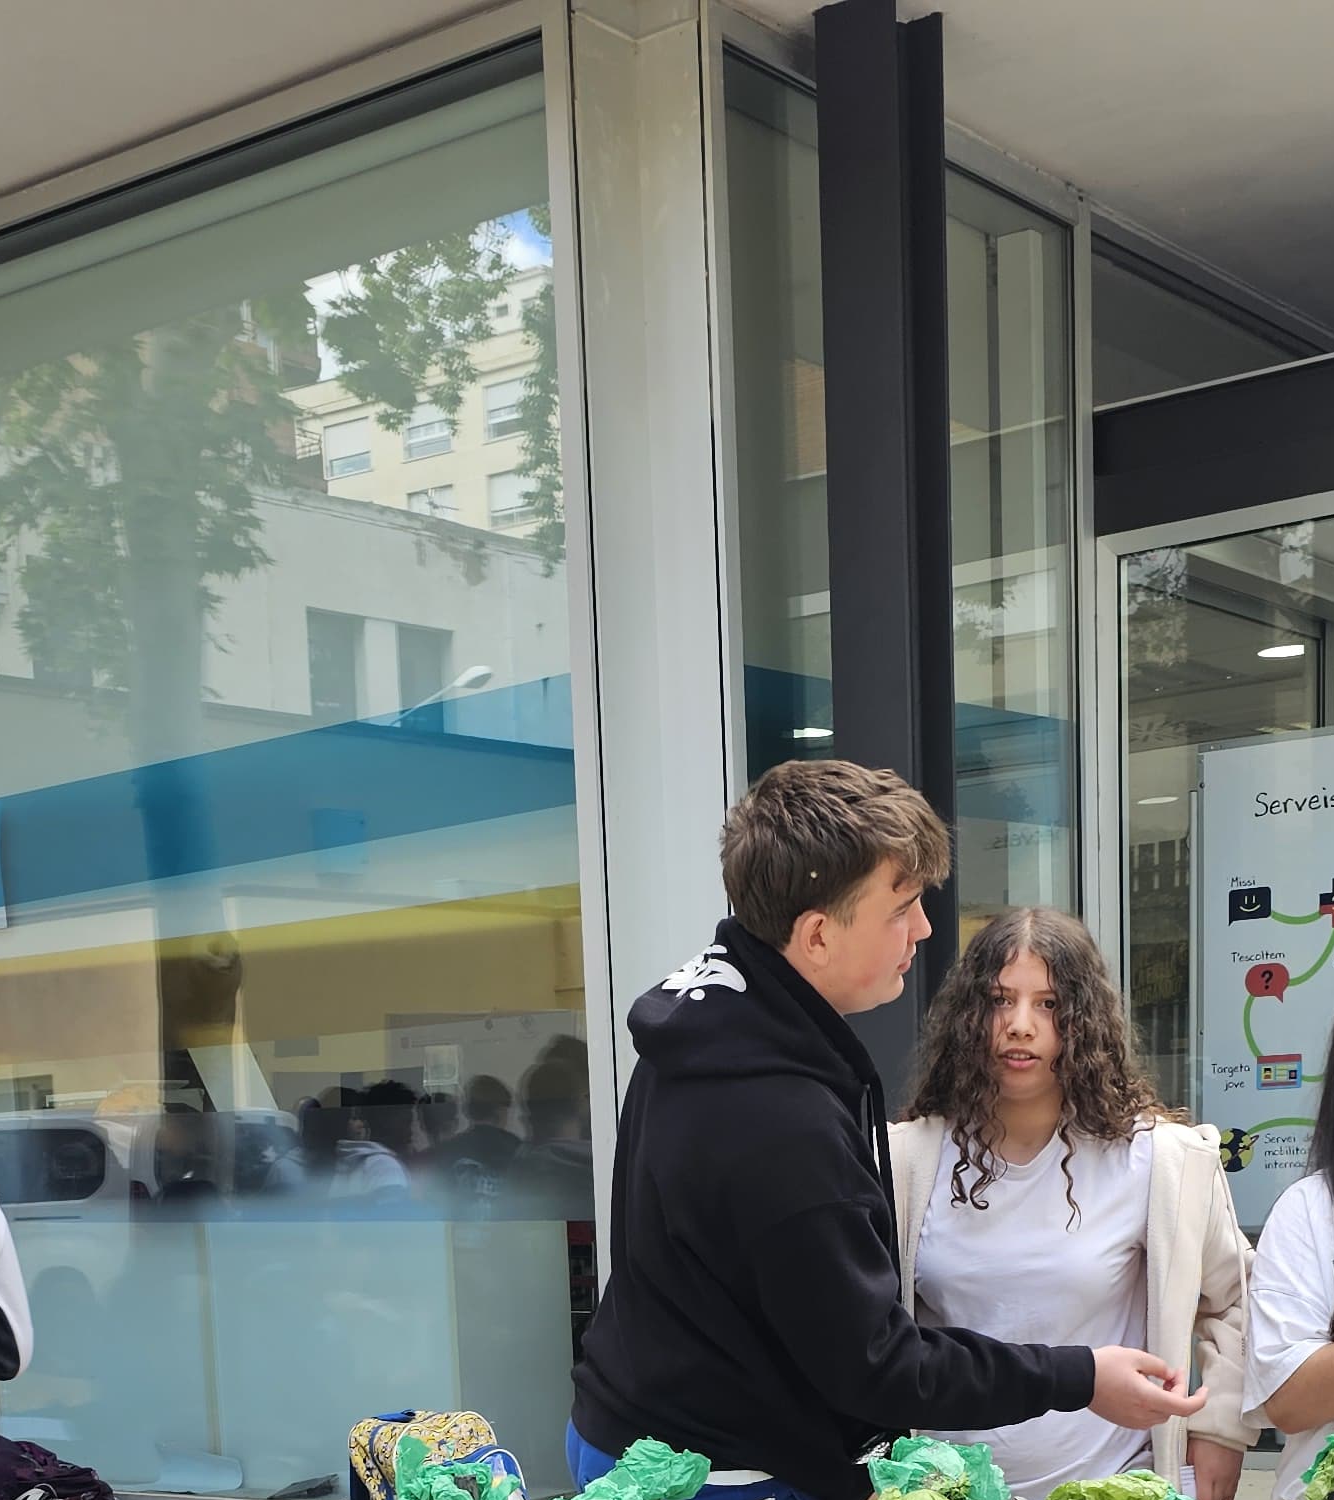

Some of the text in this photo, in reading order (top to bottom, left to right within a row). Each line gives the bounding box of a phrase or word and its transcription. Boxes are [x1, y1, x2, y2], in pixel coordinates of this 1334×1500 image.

[1230, 877, 1257, 888] Missi
[1230, 950, 1287, 963] T'escoltem
[1211, 1063, 1251, 1078] Targeta
[1224, 1080, 1246, 1092] jove
[1264, 1133, 1297, 1144] Servei
